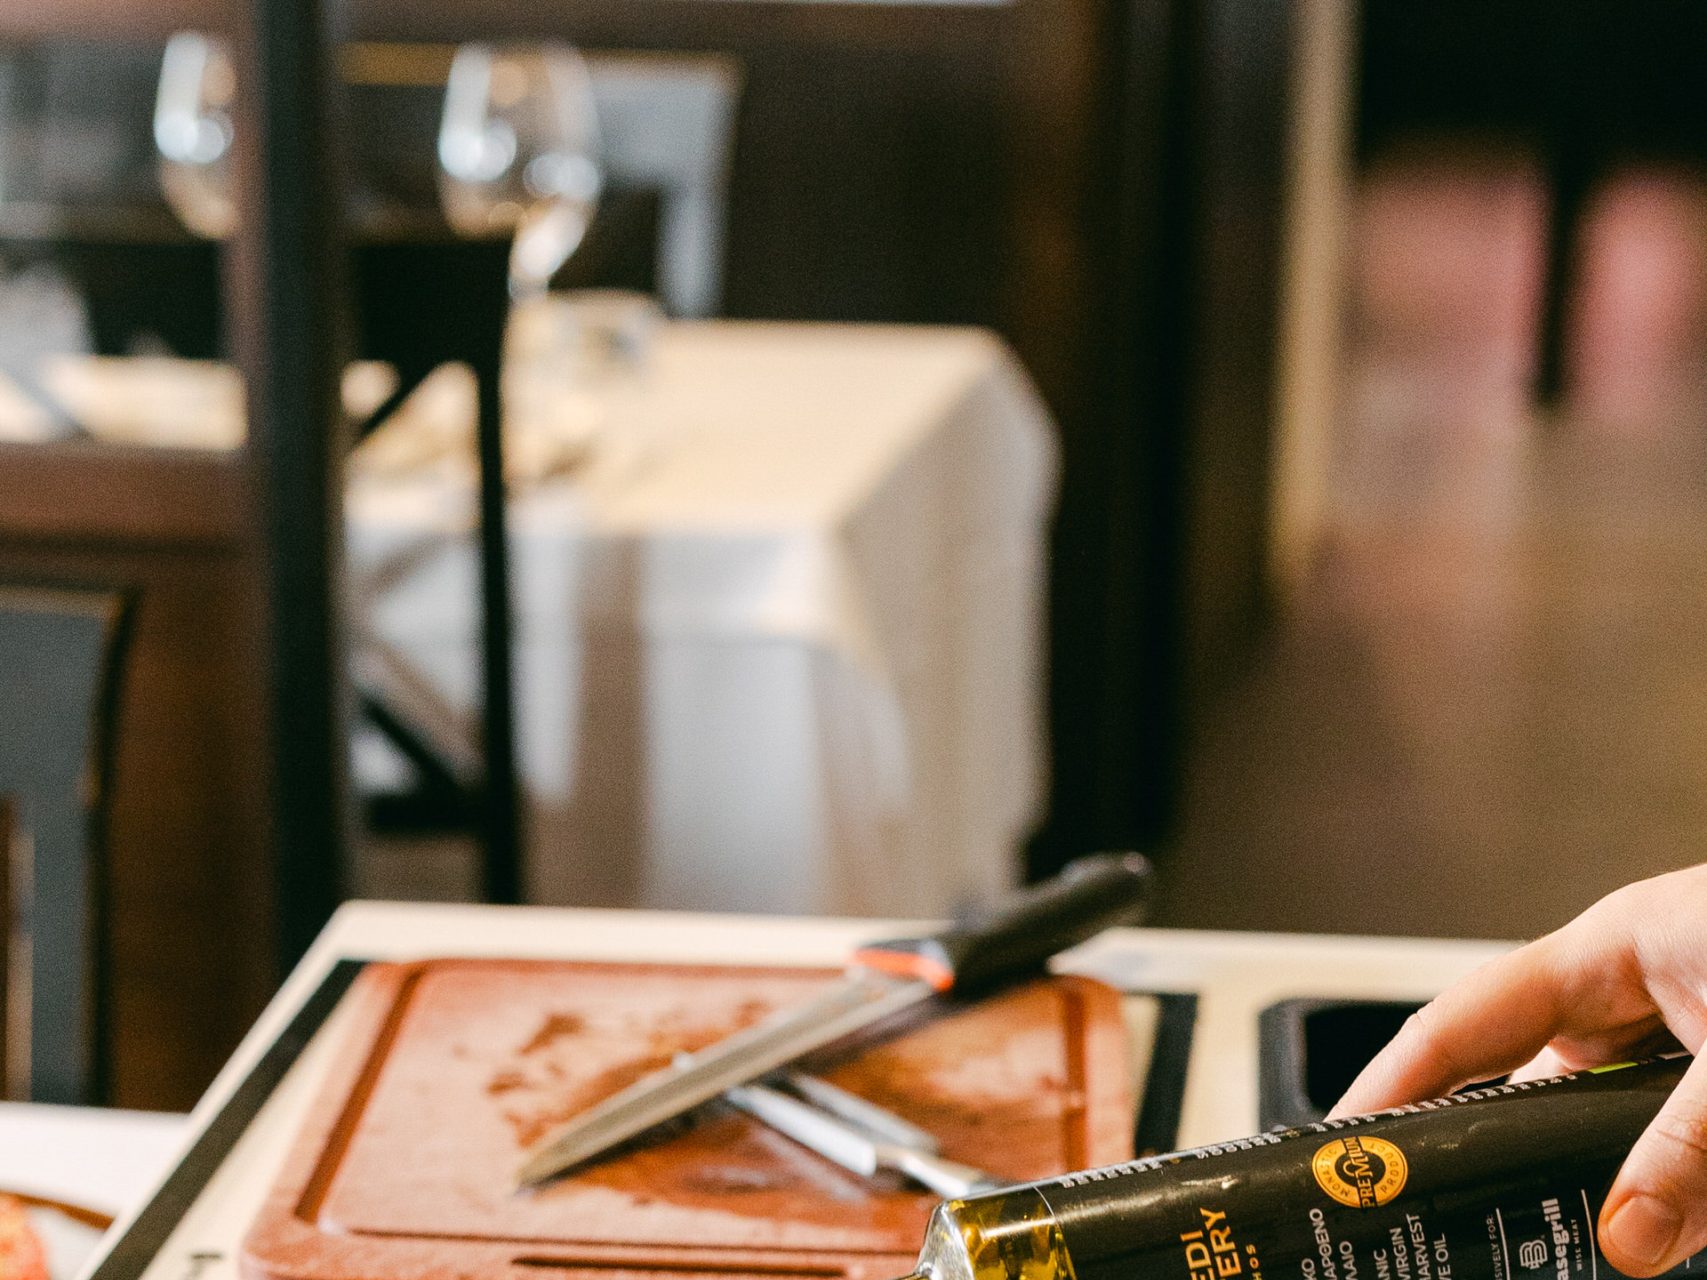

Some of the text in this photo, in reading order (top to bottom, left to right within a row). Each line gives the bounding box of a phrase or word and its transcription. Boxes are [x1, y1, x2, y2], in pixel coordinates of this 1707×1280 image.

[1343, 1136, 1376, 1208] PREMIUM
[1370, 1143, 1399, 1193] PRODUCT
[1433, 1232, 1448, 1262] OIL
